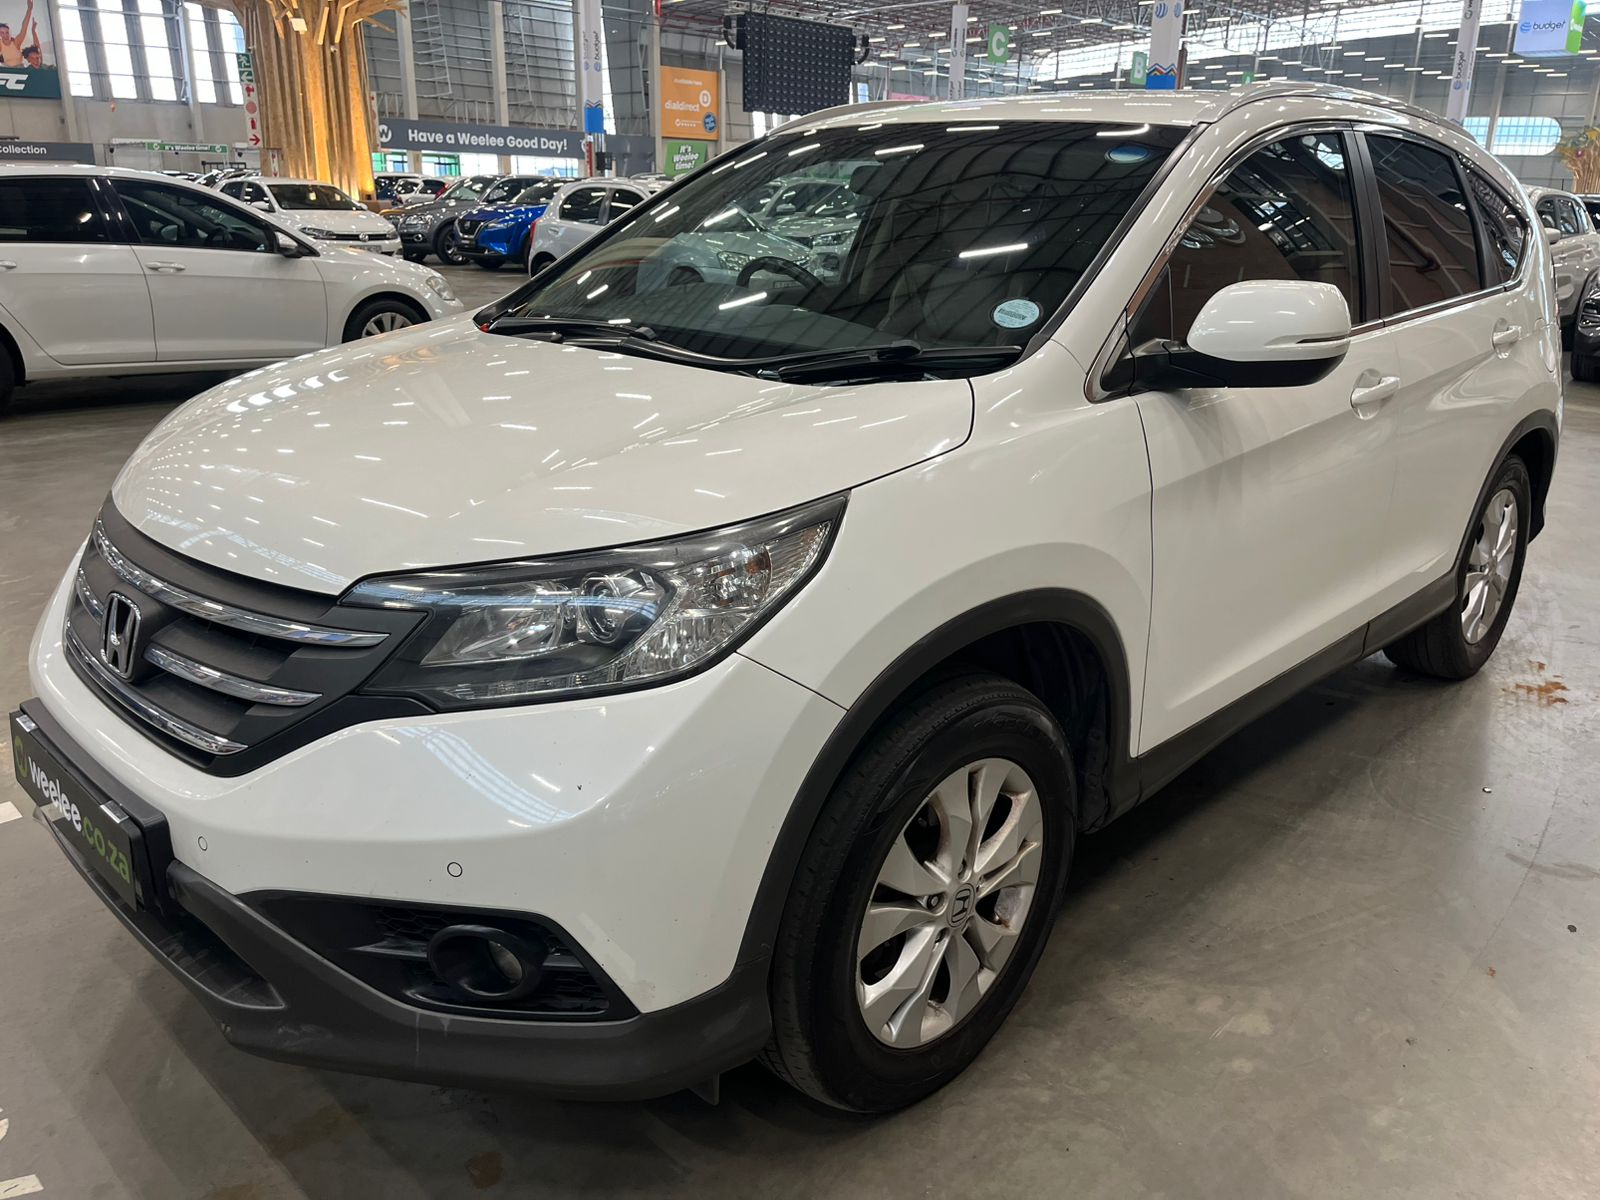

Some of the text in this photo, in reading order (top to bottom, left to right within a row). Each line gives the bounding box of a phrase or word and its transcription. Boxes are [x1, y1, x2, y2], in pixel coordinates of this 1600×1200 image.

[1533, 20, 1566, 32] budget
[992, 31, 1005, 57] C
[1134, 57, 1144, 79] B
[0, 145, 47, 154] ollection
[408, 129, 568, 154] Have a Weelee Good Day!
[28, 756, 130, 884] weelee.co.za
